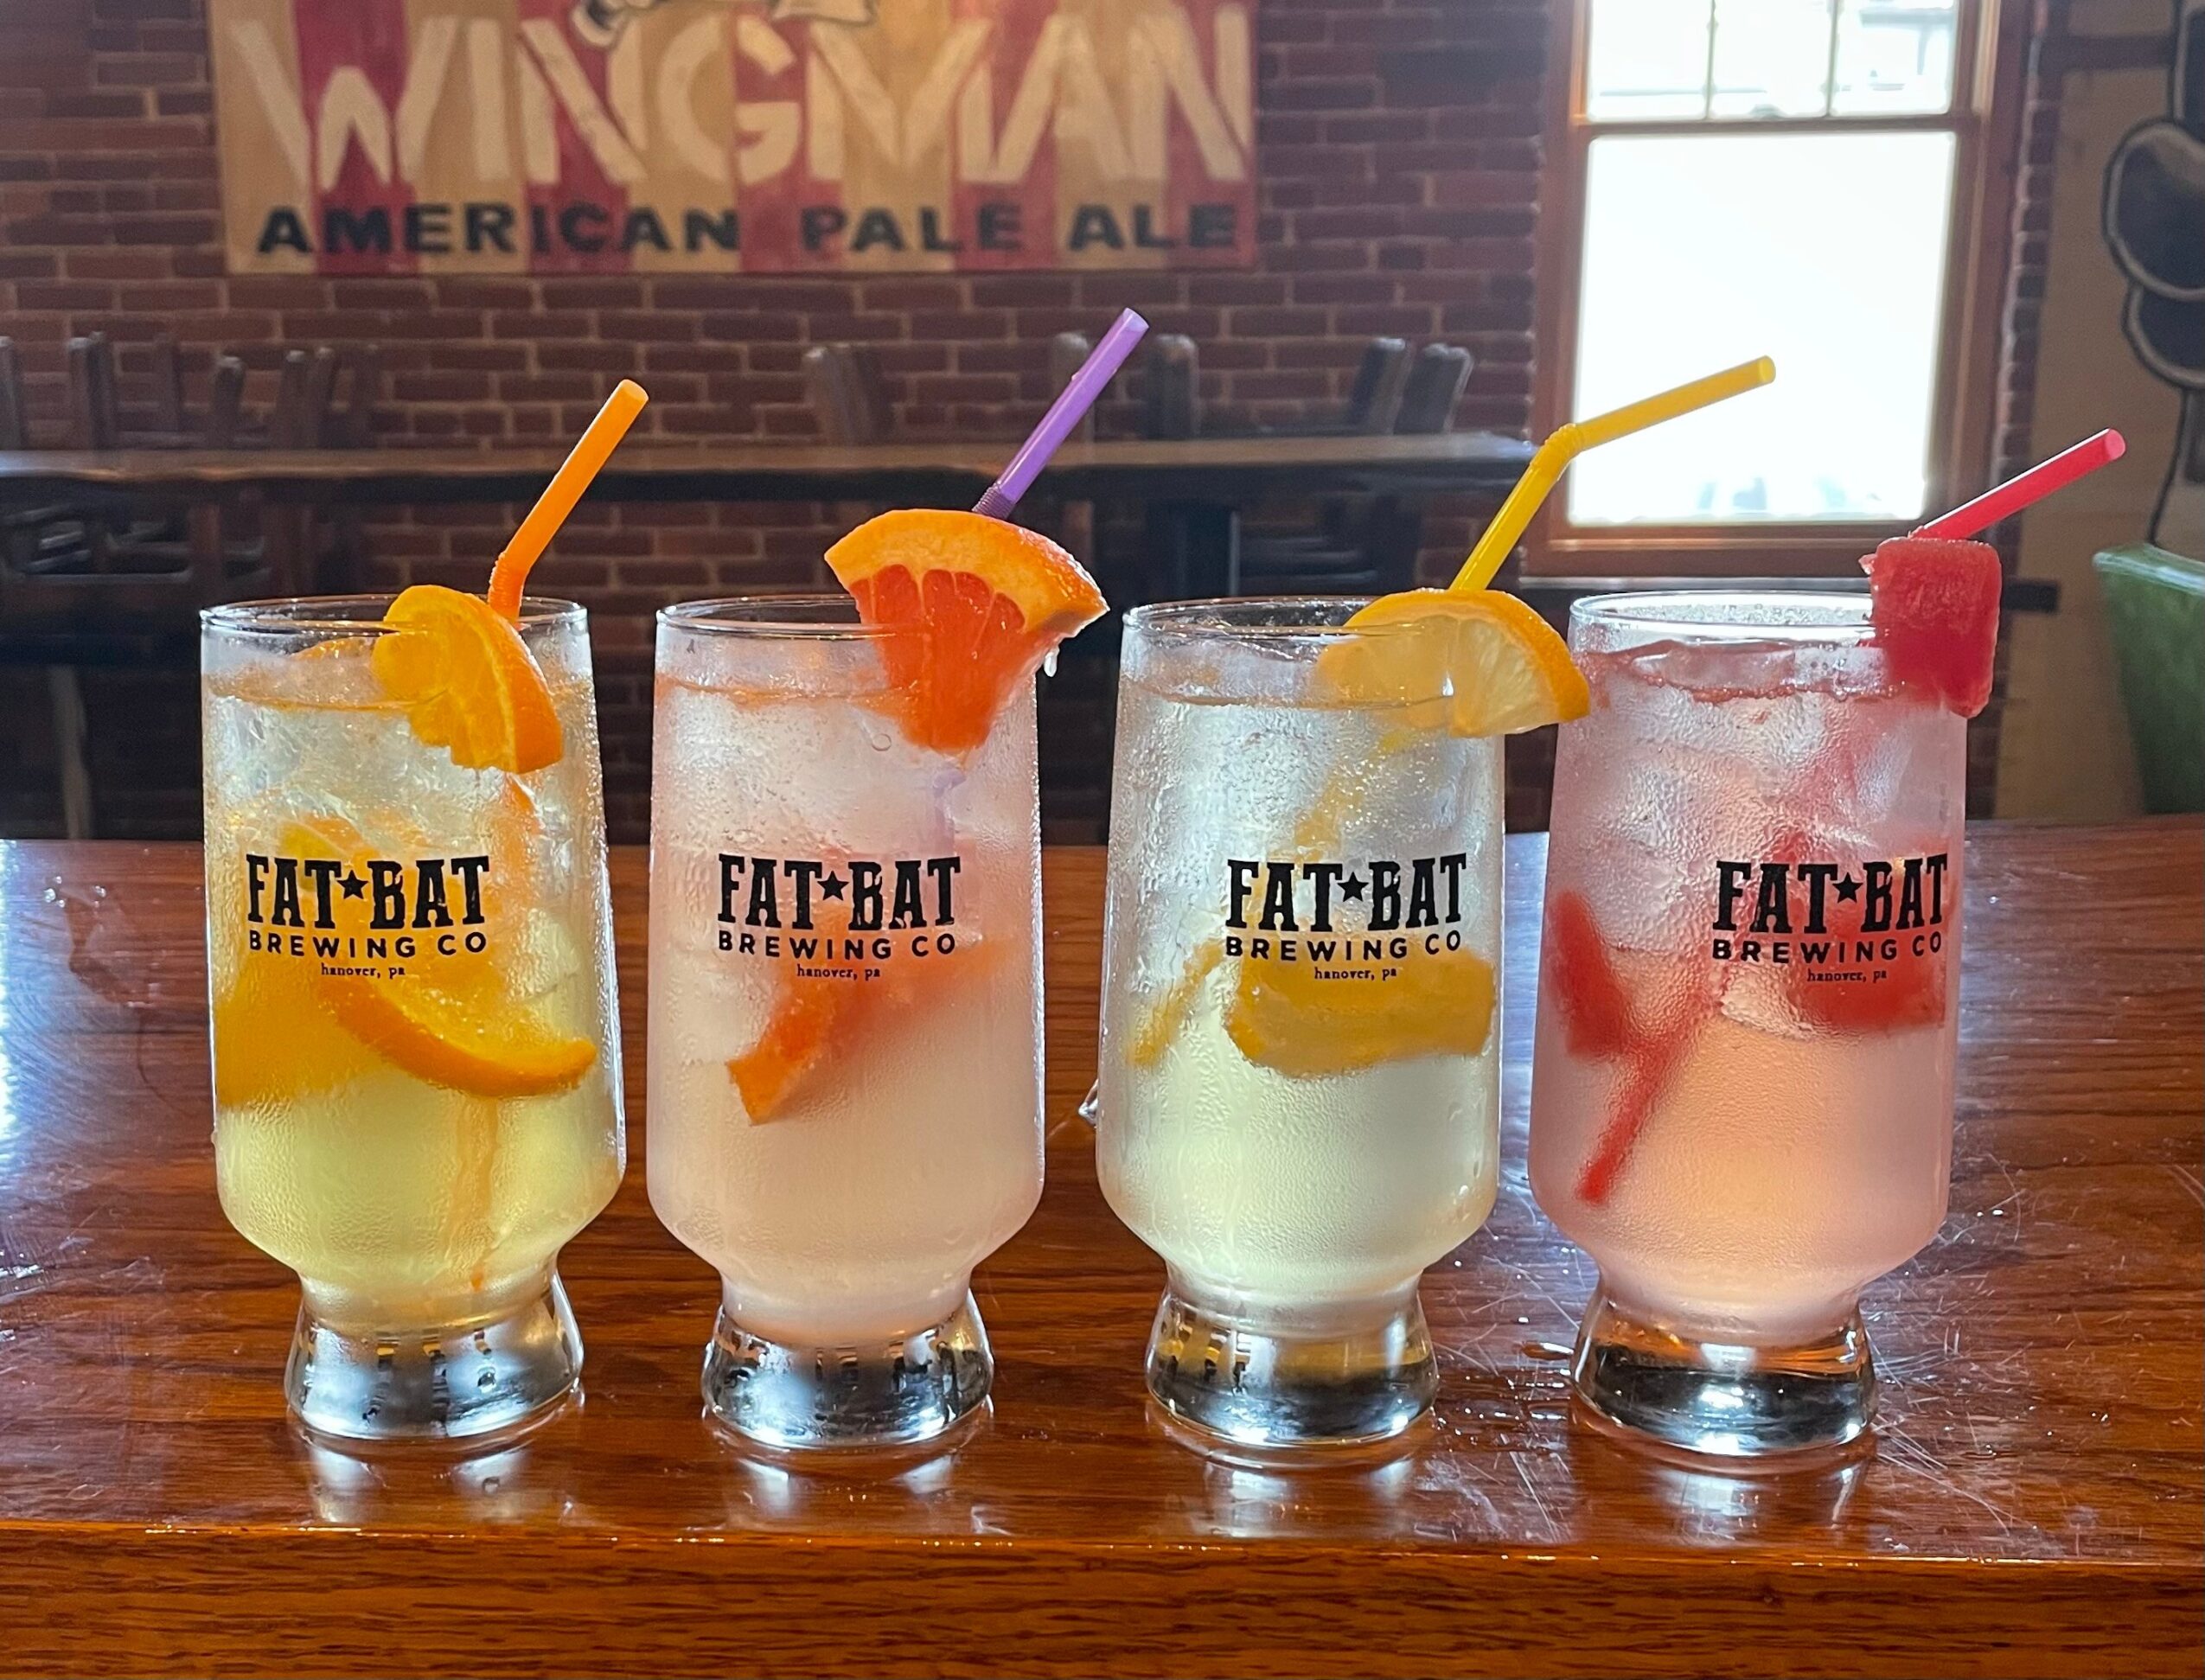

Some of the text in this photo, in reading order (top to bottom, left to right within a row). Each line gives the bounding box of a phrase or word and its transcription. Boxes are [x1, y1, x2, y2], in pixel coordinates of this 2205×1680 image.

[227, 9, 1250, 192] WINGMAN
[255, 202, 1237, 254] AMERICAN PALE ALE
[250, 930, 486, 957] BREWING CO
[719, 930, 956, 960] BREWING CO
[1226, 930, 1460, 961] BREWING CO
[1712, 931, 1941, 964] BREWING CO
[321, 962, 405, 979] hanover, pa
[797, 964, 880, 981] hanover, pa
[1314, 967, 1396, 981] hanover, pa
[1807, 969, 1887, 983] hanover, pa
